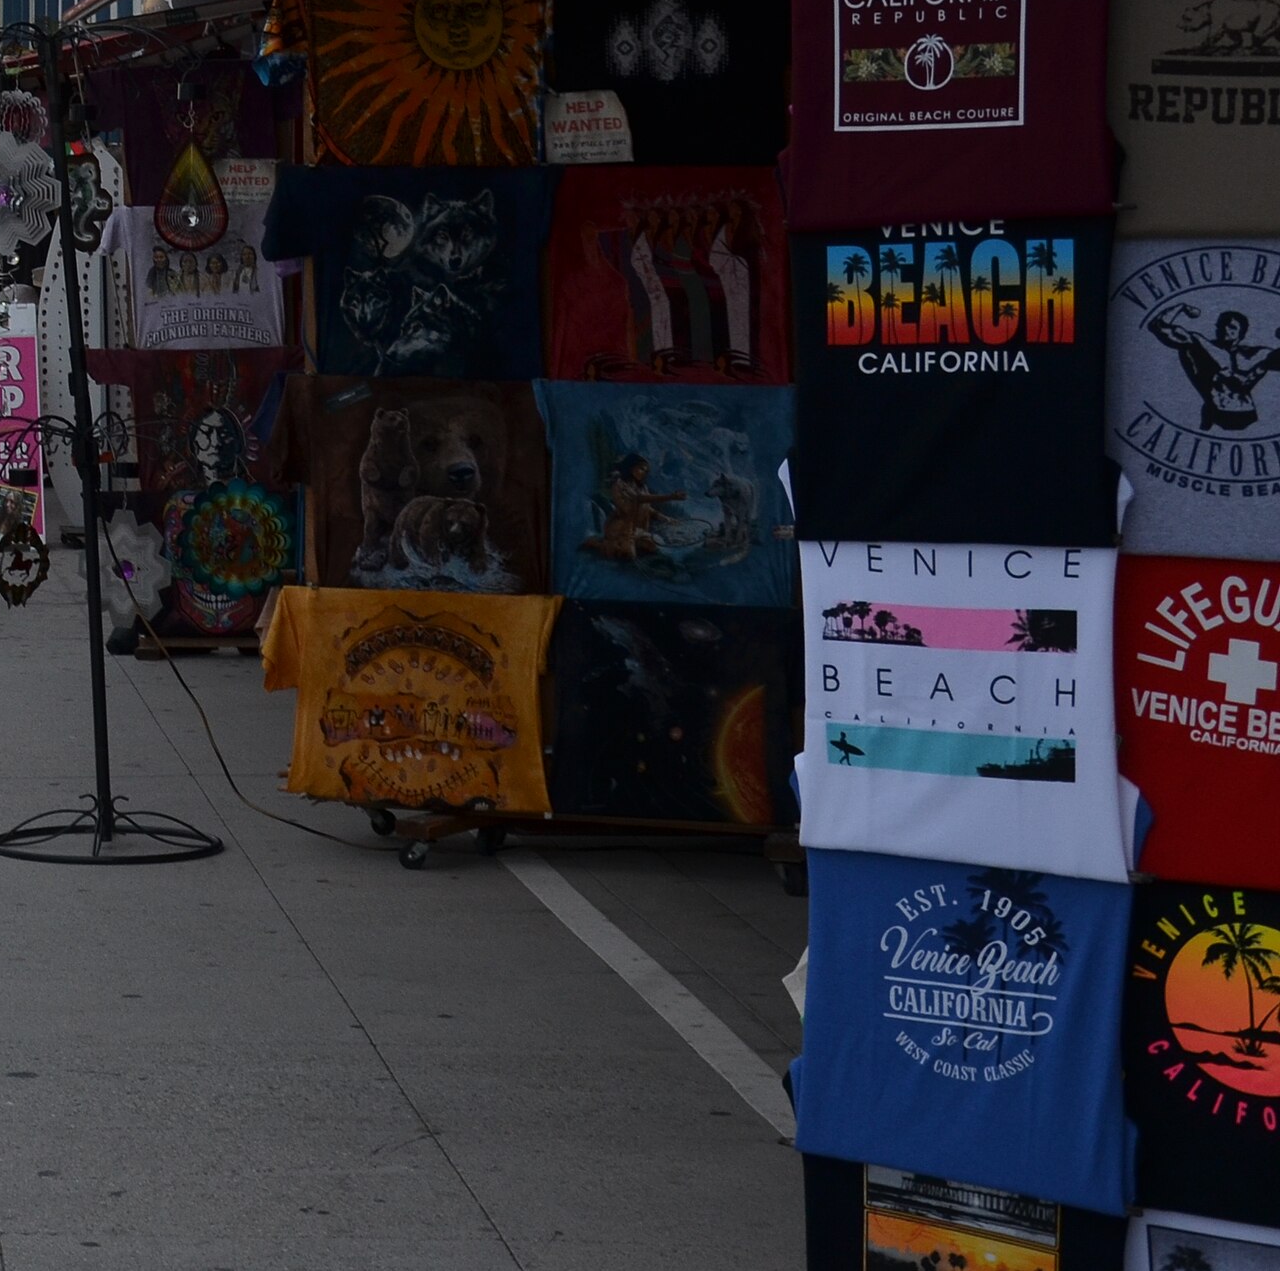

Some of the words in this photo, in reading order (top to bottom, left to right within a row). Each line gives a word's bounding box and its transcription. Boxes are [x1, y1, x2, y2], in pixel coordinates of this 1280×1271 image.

[851, 6, 1008, 25] REPUBLIC
[566, 100, 605, 114] HELP
[843, 113, 904, 123] ORIGINAL
[909, 110, 951, 121] BEACH
[956, 107, 1014, 119] COUTURE
[552, 118, 622, 133] WANTED
[220, 176, 269, 186] WANTED
[229, 164, 256, 173] HELP
[825, 238, 1076, 346] BEACH
[1121, 251, 1233, 311] VENICE
[161, 308, 188, 326] THE
[193, 307, 253, 325] ORIGINAL
[145, 323, 208, 349] FOUNDING
[213, 323, 271, 345] FATHERS
[857, 351, 1030, 374] CALIFORNIA
[1126, 412, 1280, 476] CALIFOR
[1146, 462, 1231, 497] MUSCLE
[819, 541, 1081, 578] VENICE
[1137, 575, 1280, 671] LIFEGU
[823, 664, 1075, 707] BEACH
[825, 712, 1075, 735] CALIFORNIA
[1131, 687, 1238, 735] VENICE
[895, 884, 958, 922] EST.
[980, 889, 1048, 946] 1905
[1131, 890, 1247, 980] VENICE
[880, 925, 971, 976] Venice
[970, 940, 1061, 996] Beach
[889, 985, 1028, 1028] CALIFORNIA
[895, 1030, 930, 1065] WEST
[933, 1059, 977, 1082] COAST
[984, 1048, 1035, 1082] CLASSIC
[931, 1027, 958, 1046] So
[963, 1032, 998, 1051] Cal
